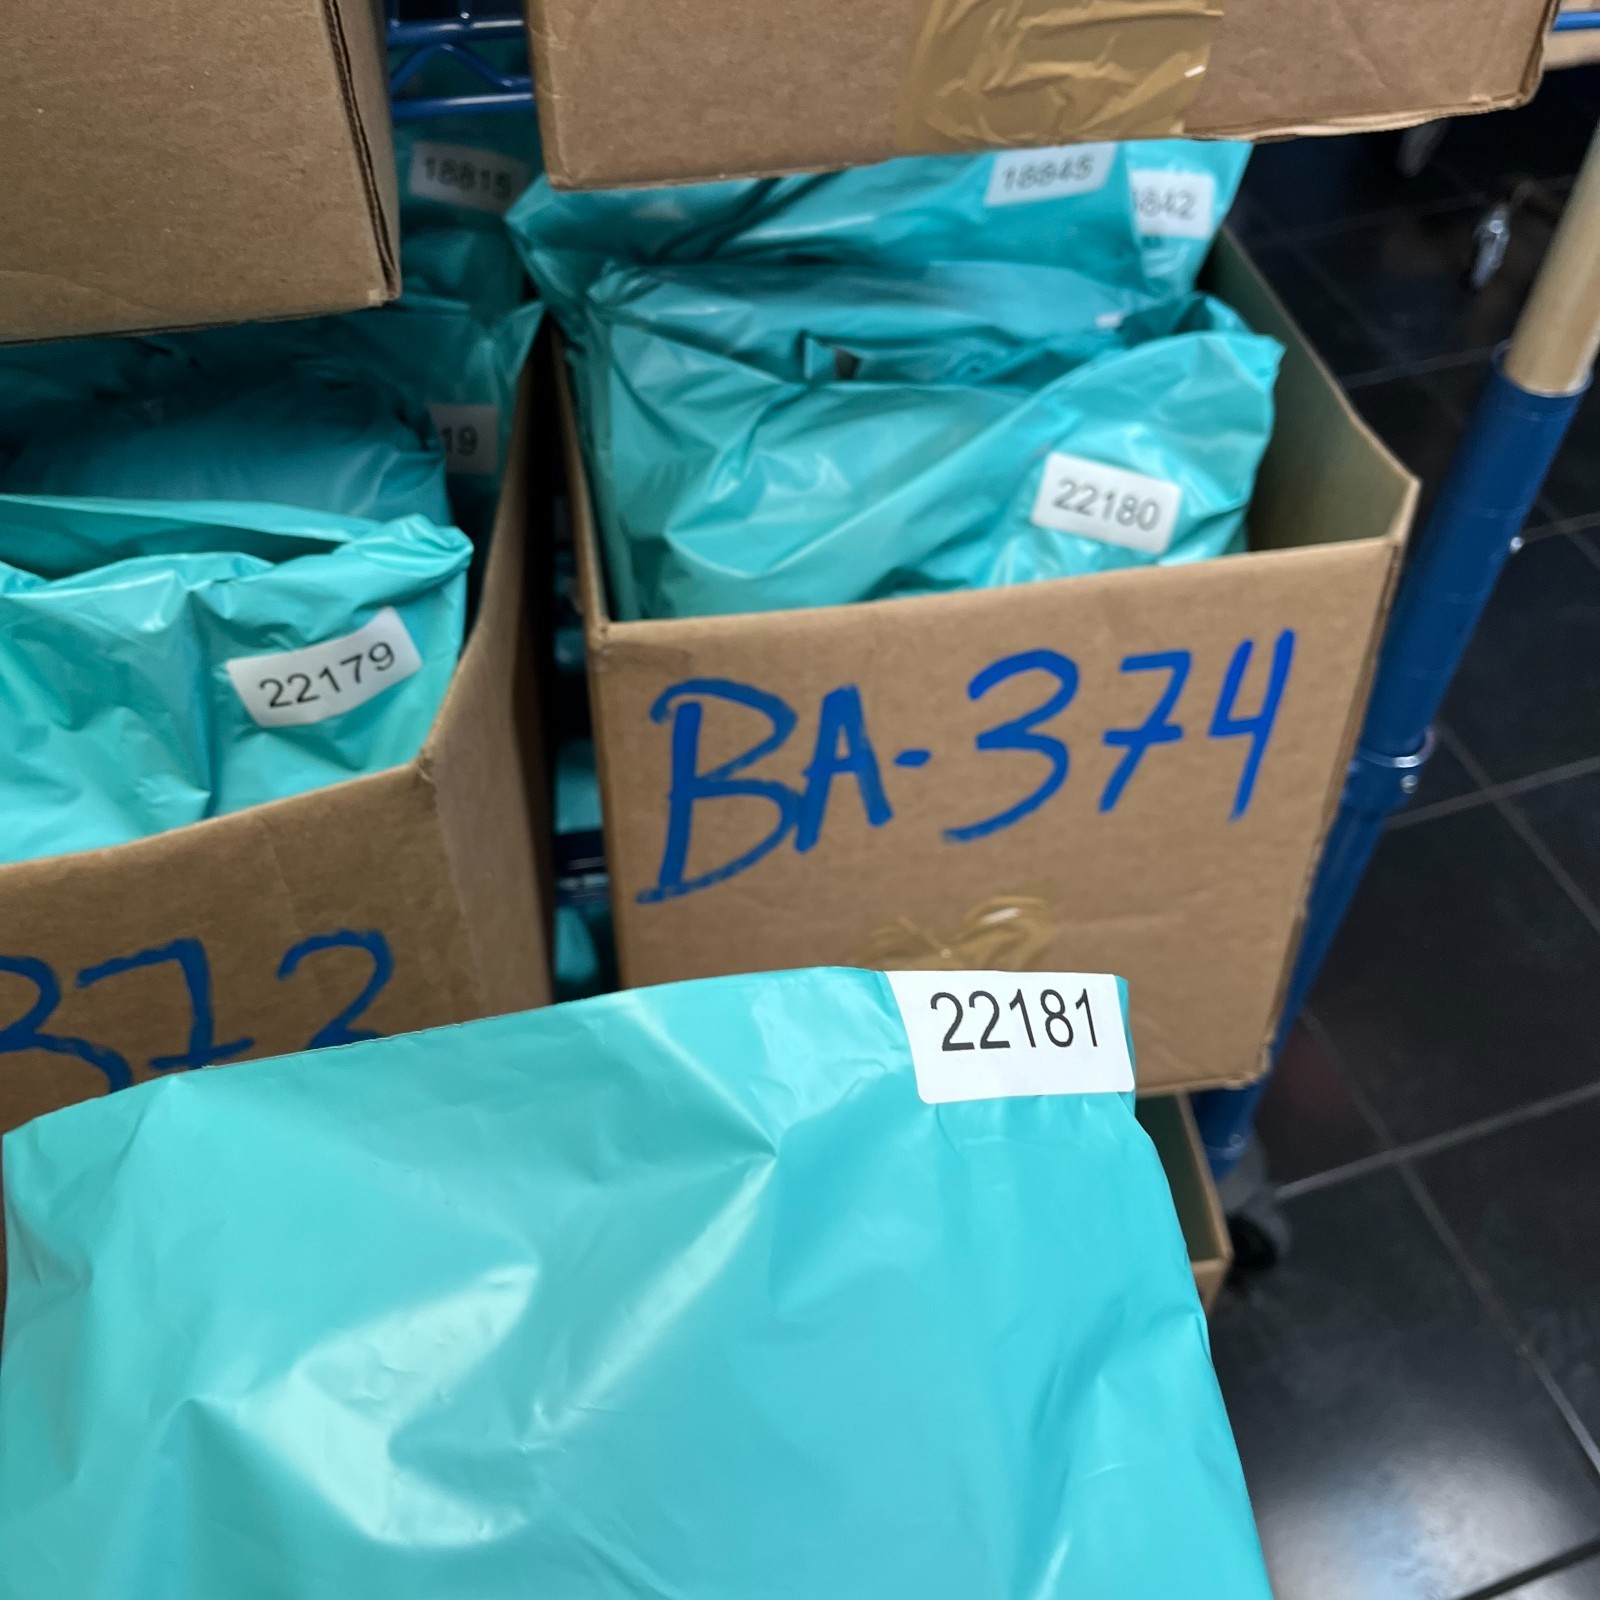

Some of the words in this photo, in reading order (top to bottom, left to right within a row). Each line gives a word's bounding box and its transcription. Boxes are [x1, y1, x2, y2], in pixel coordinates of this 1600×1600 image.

[1051, 476, 1162, 532] 22180
[258, 641, 396, 710] 22179
[636, 628, 1296, 904] BA-374
[929, 987, 1099, 1052] 22181
